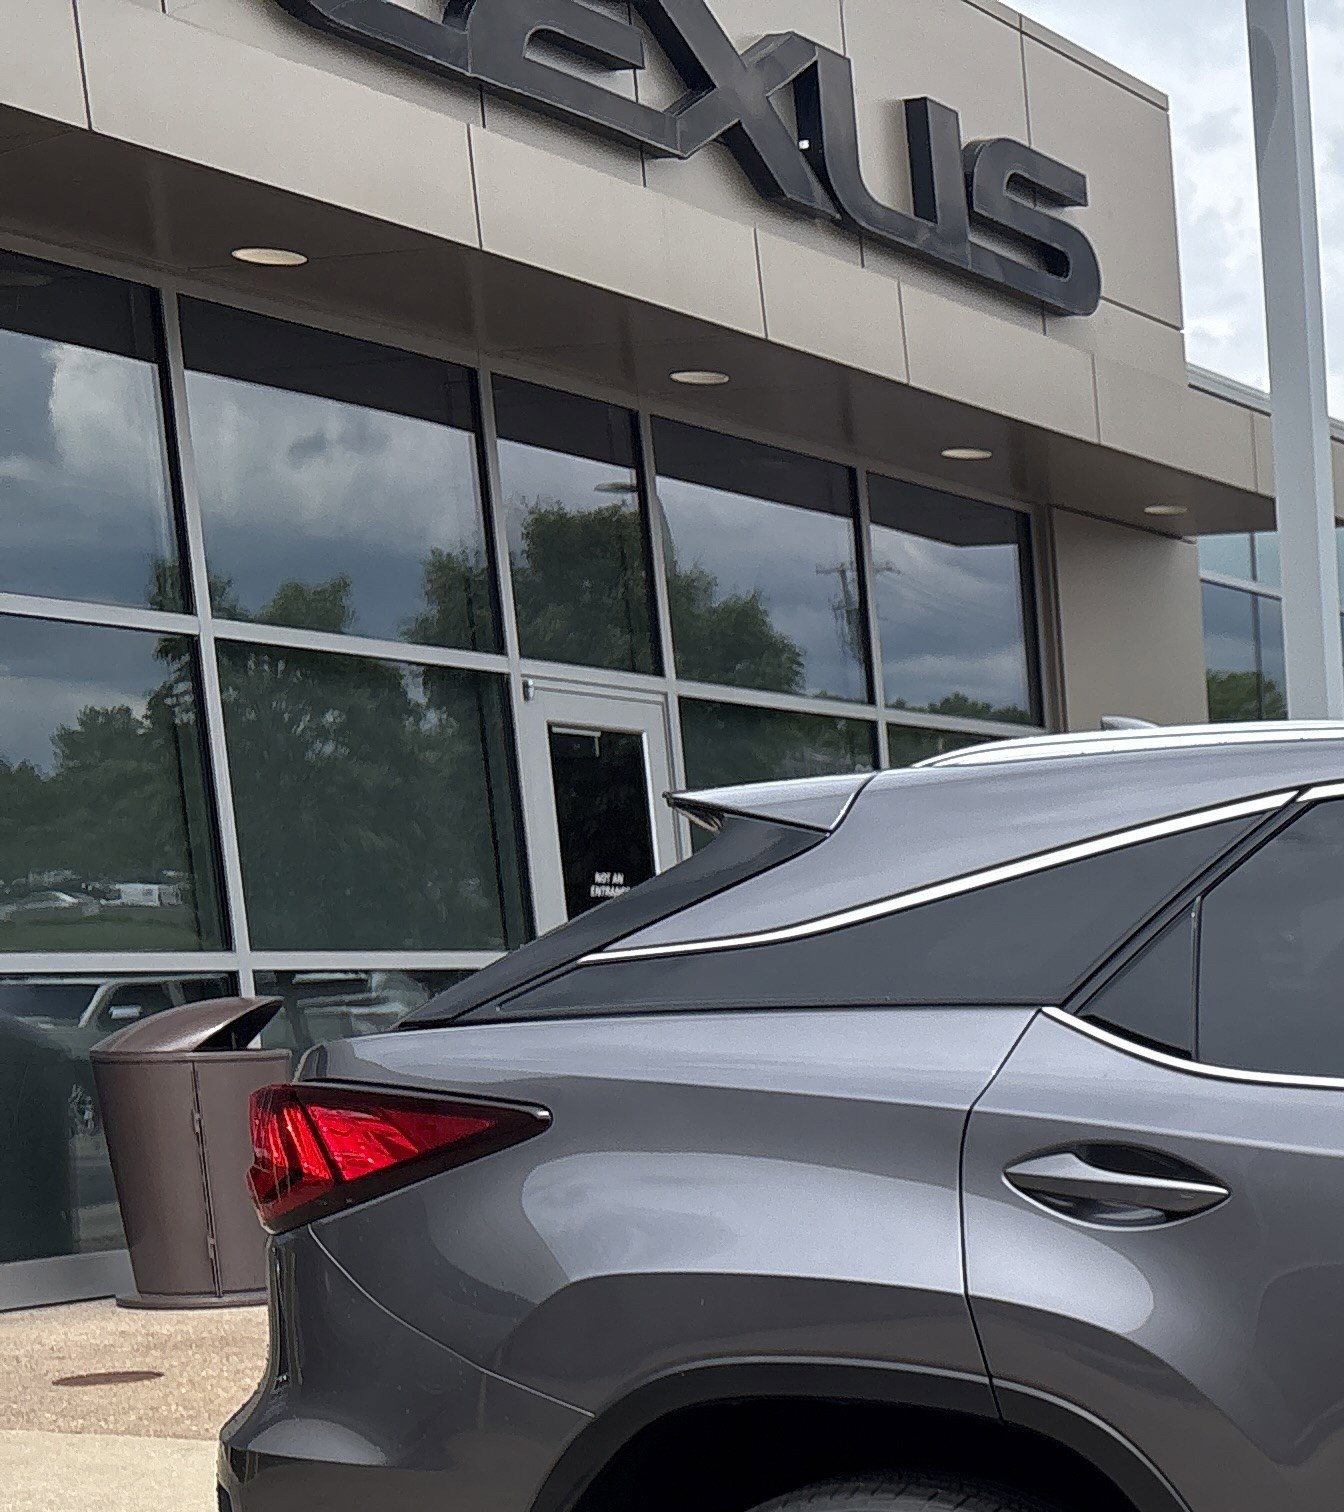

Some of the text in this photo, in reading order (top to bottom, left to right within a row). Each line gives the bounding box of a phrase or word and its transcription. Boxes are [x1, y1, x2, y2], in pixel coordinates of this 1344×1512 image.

[275, 0, 1102, 316] EXUS
[594, 871, 624, 885] NOT AN
